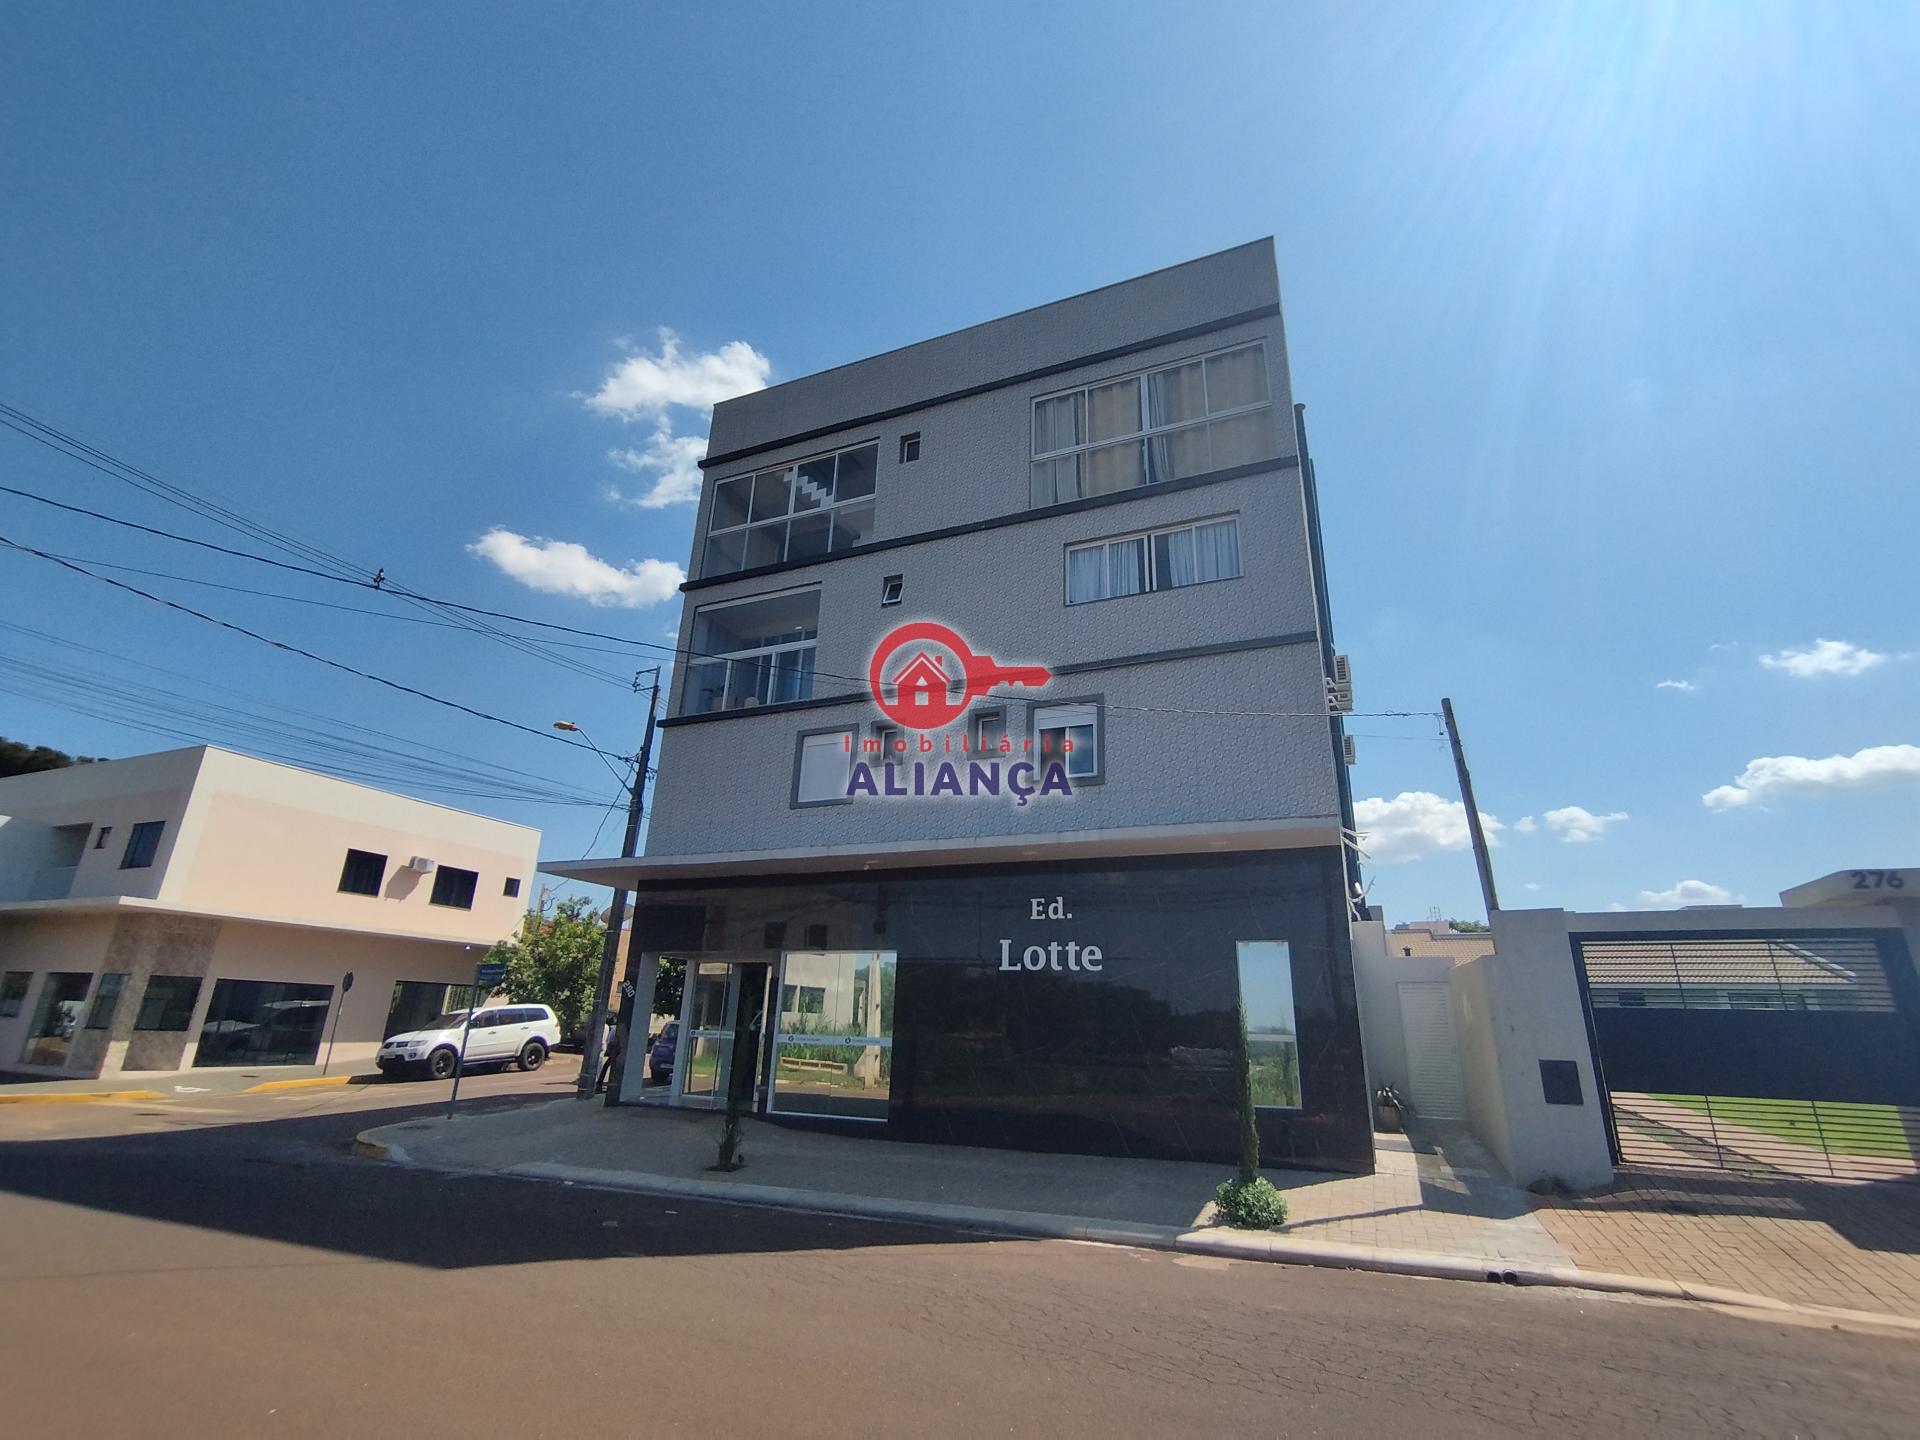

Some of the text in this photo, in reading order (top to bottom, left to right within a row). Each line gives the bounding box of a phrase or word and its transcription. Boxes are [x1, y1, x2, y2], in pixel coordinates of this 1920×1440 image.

[1851, 871, 1905, 889] 276
[1030, 897, 1073, 920] Ed.
[999, 939, 1103, 971] Lotte
